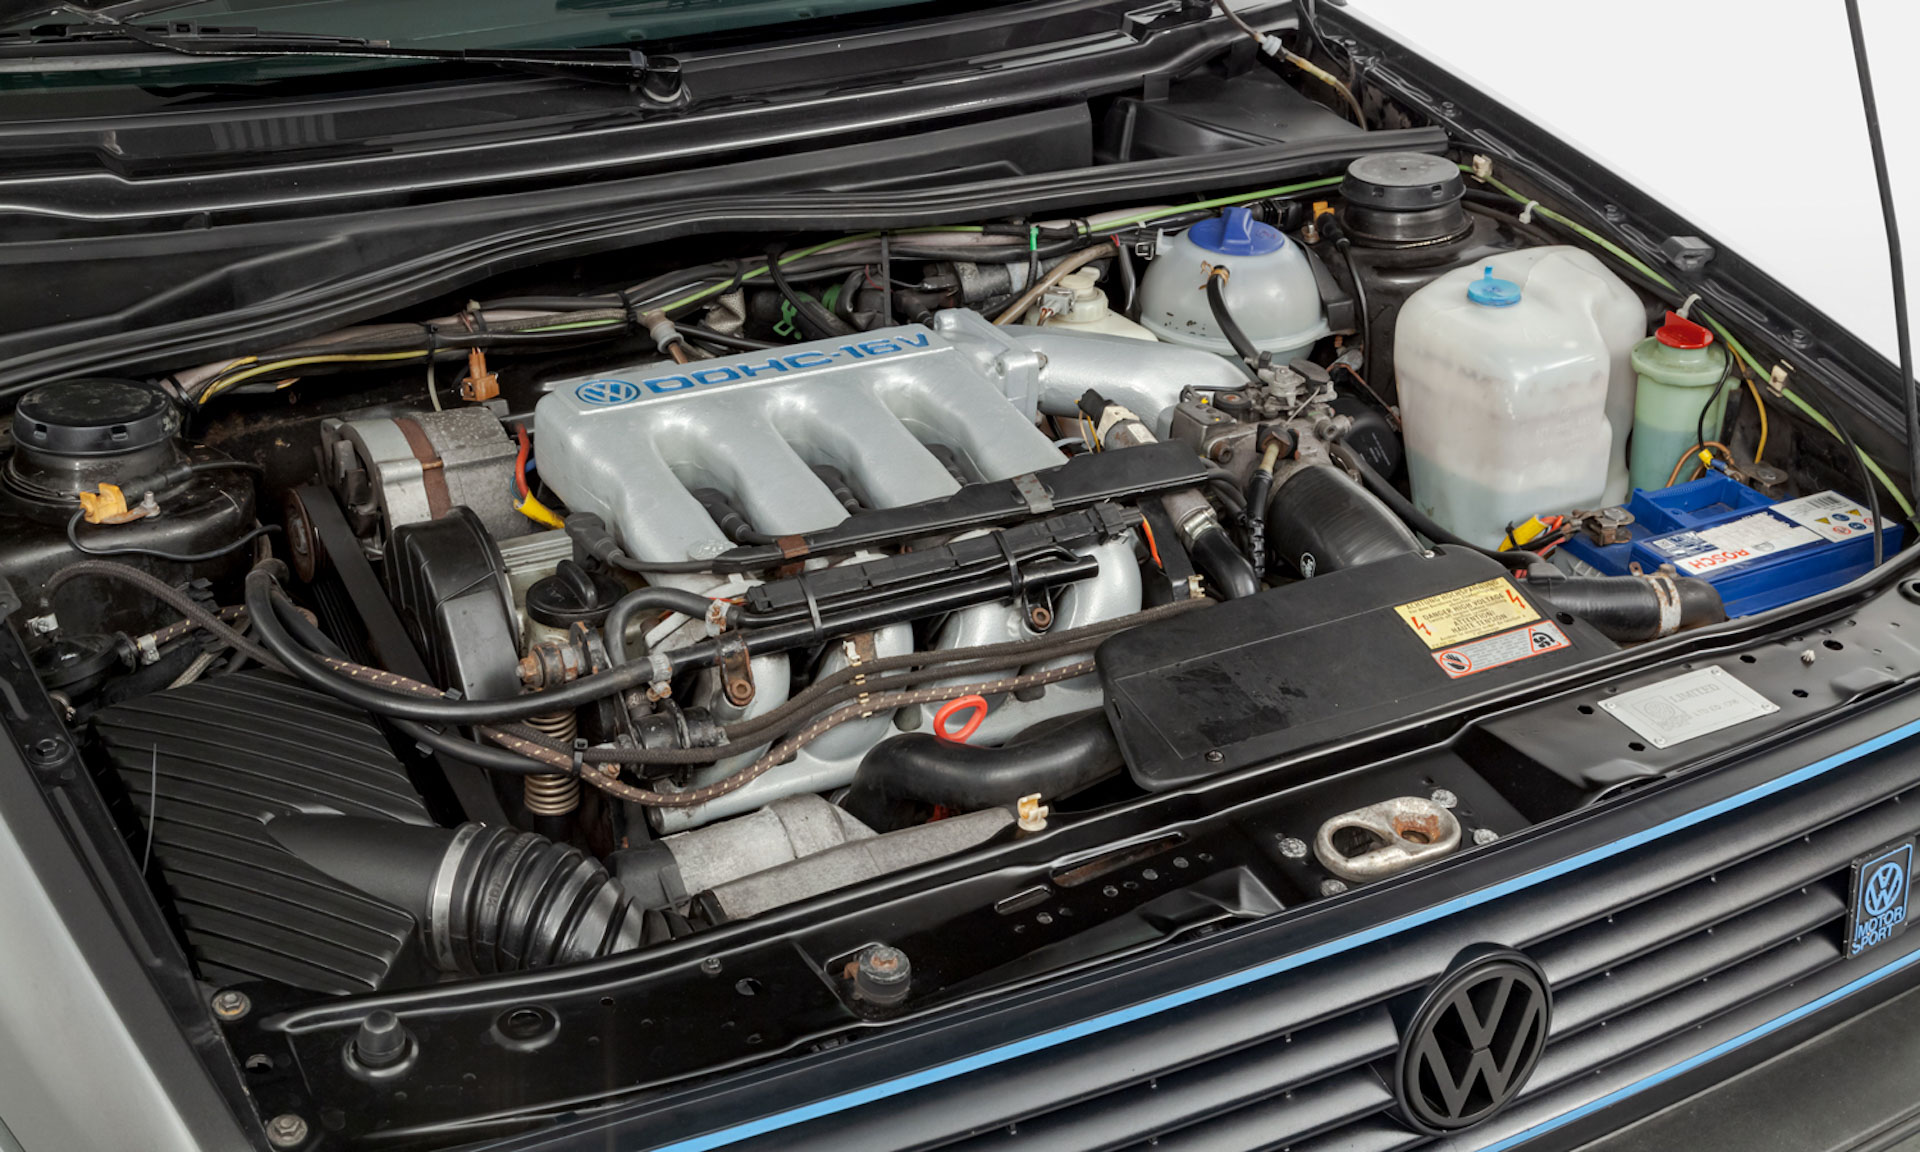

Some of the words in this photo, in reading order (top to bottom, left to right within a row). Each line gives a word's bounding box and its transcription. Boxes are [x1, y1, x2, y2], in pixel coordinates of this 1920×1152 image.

[1422, 608, 1452, 620] DANGER
[1452, 602, 1473, 612] HIGH
[1473, 593, 1505, 606] VOLTAGE
[1450, 622, 1475, 633] HAUTE
[1476, 613, 1507, 626] TENSION
[1668, 683, 1721, 703] LIMITED
[1865, 862, 1903, 916] VW
[1858, 906, 1904, 939] MOTOR
[1852, 924, 1893, 955] SPORT
[1411, 968, 1544, 1122] VW
